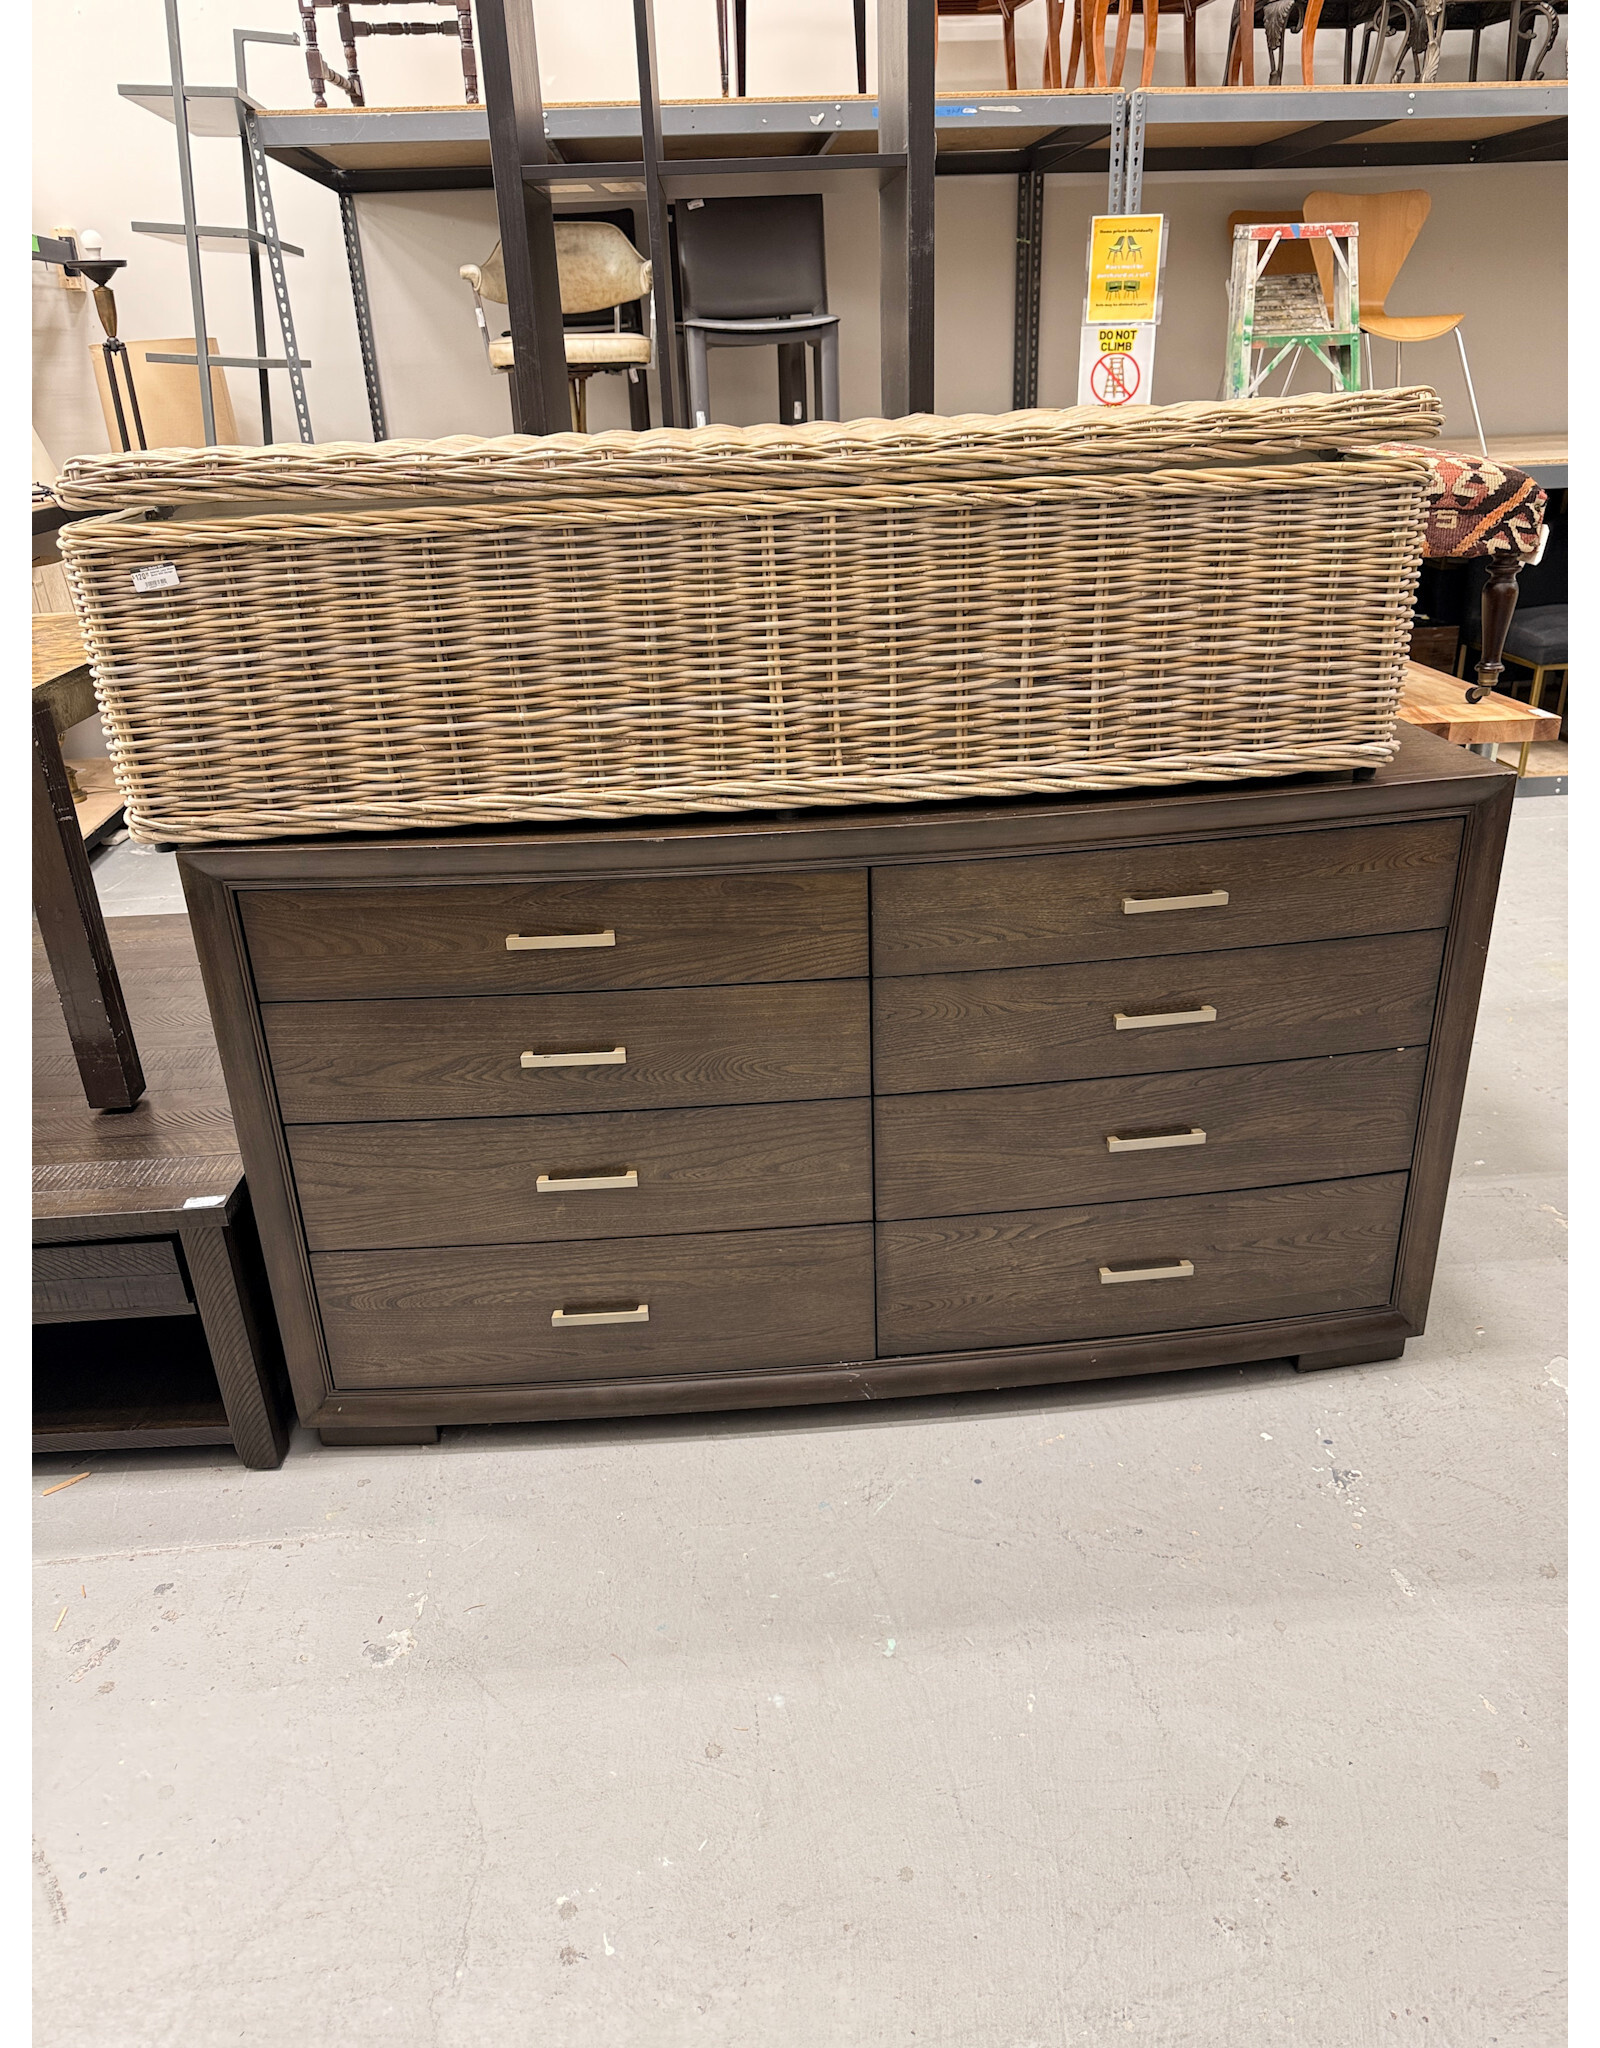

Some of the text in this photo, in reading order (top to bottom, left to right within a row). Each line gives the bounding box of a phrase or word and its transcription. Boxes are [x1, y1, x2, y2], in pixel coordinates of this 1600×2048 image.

[1100, 330, 1137, 340] DO NOT
[1101, 342, 1132, 351] CLIMB
